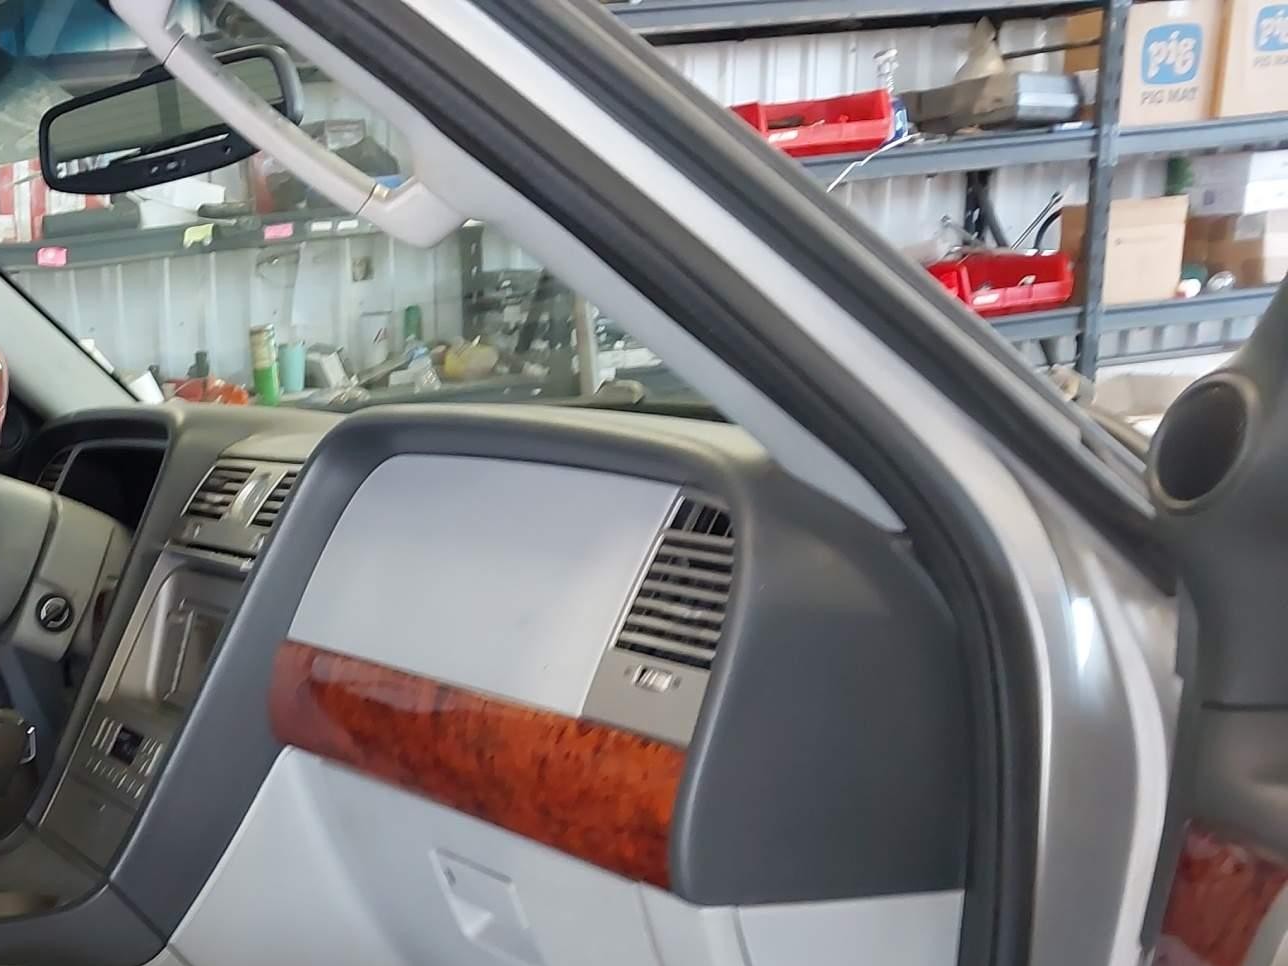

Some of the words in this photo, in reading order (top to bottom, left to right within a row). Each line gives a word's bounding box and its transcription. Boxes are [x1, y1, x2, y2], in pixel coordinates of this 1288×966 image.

[1147, 30, 1196, 79] pig
[1140, 90, 1164, 105] PIG
[1167, 87, 1198, 102] MAT
